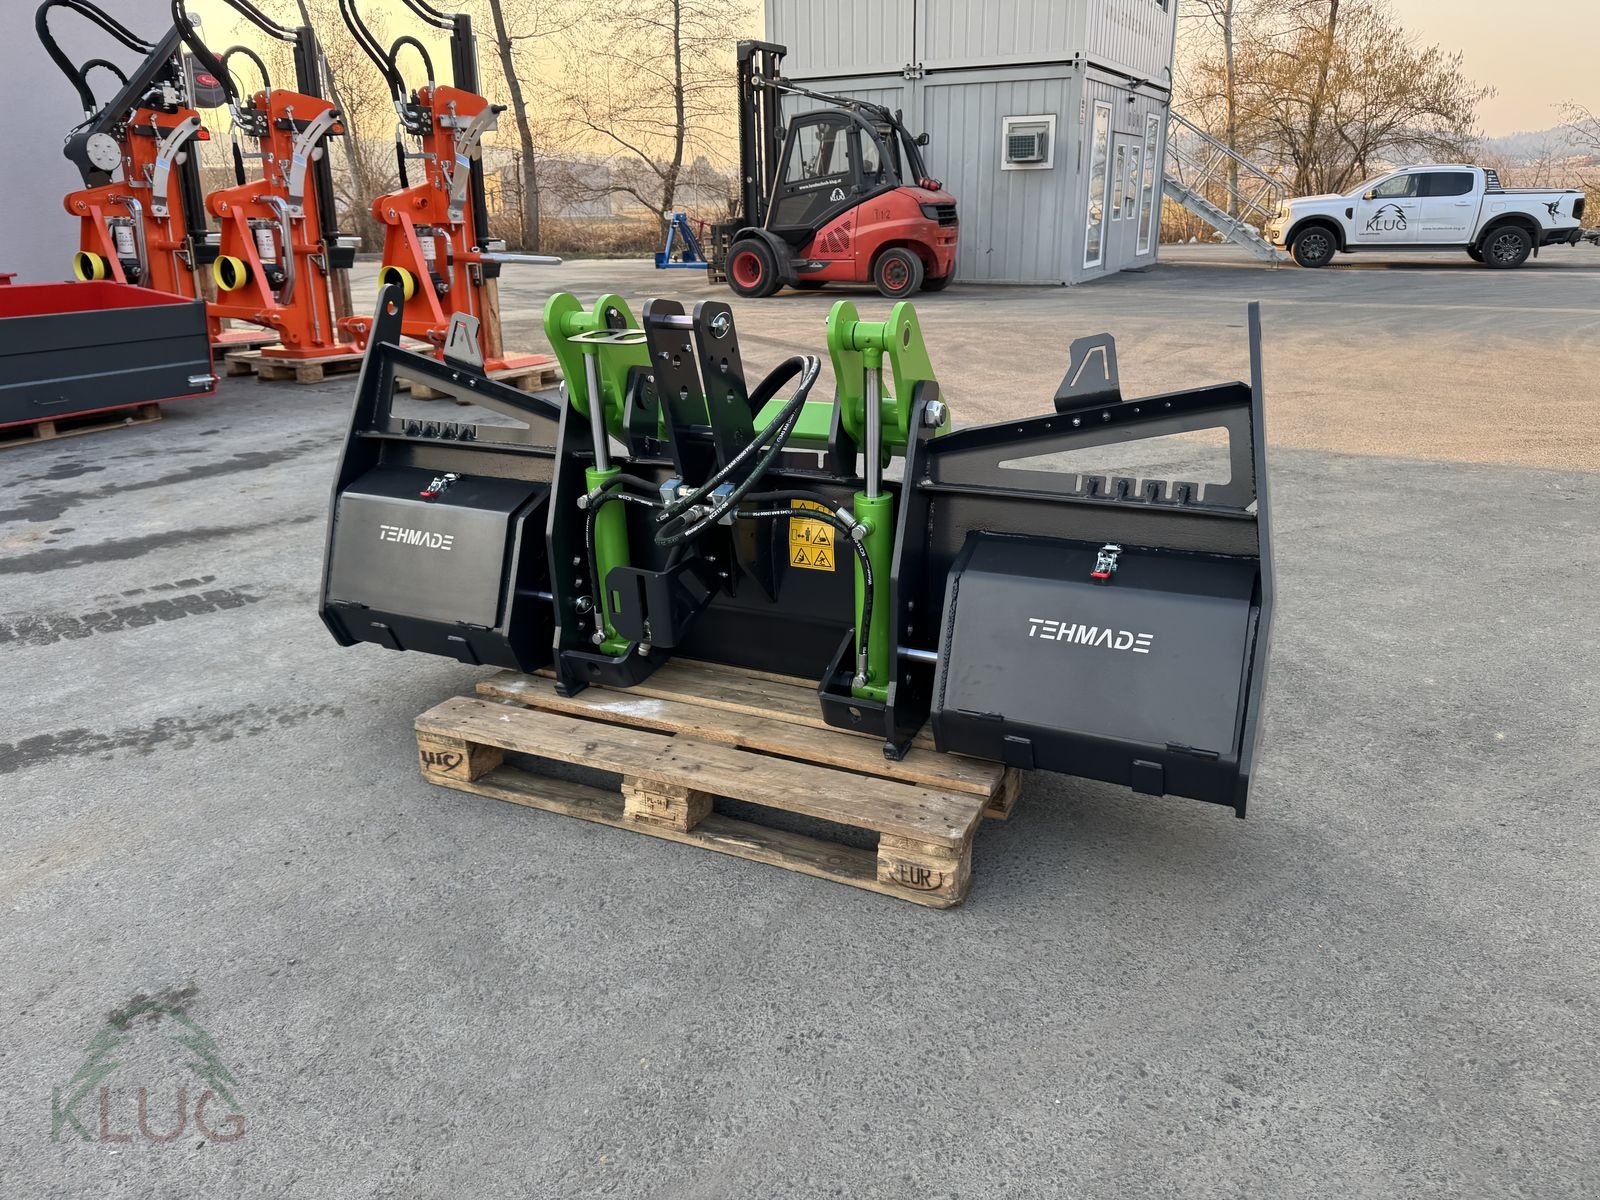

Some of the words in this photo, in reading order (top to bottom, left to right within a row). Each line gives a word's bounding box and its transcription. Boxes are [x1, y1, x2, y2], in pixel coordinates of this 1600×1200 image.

[1366, 219, 1407, 231] KLUG
[380, 524, 454, 551] TEHMADE
[1028, 617, 1154, 654] TEHMADE
[900, 864, 932, 888] EUR
